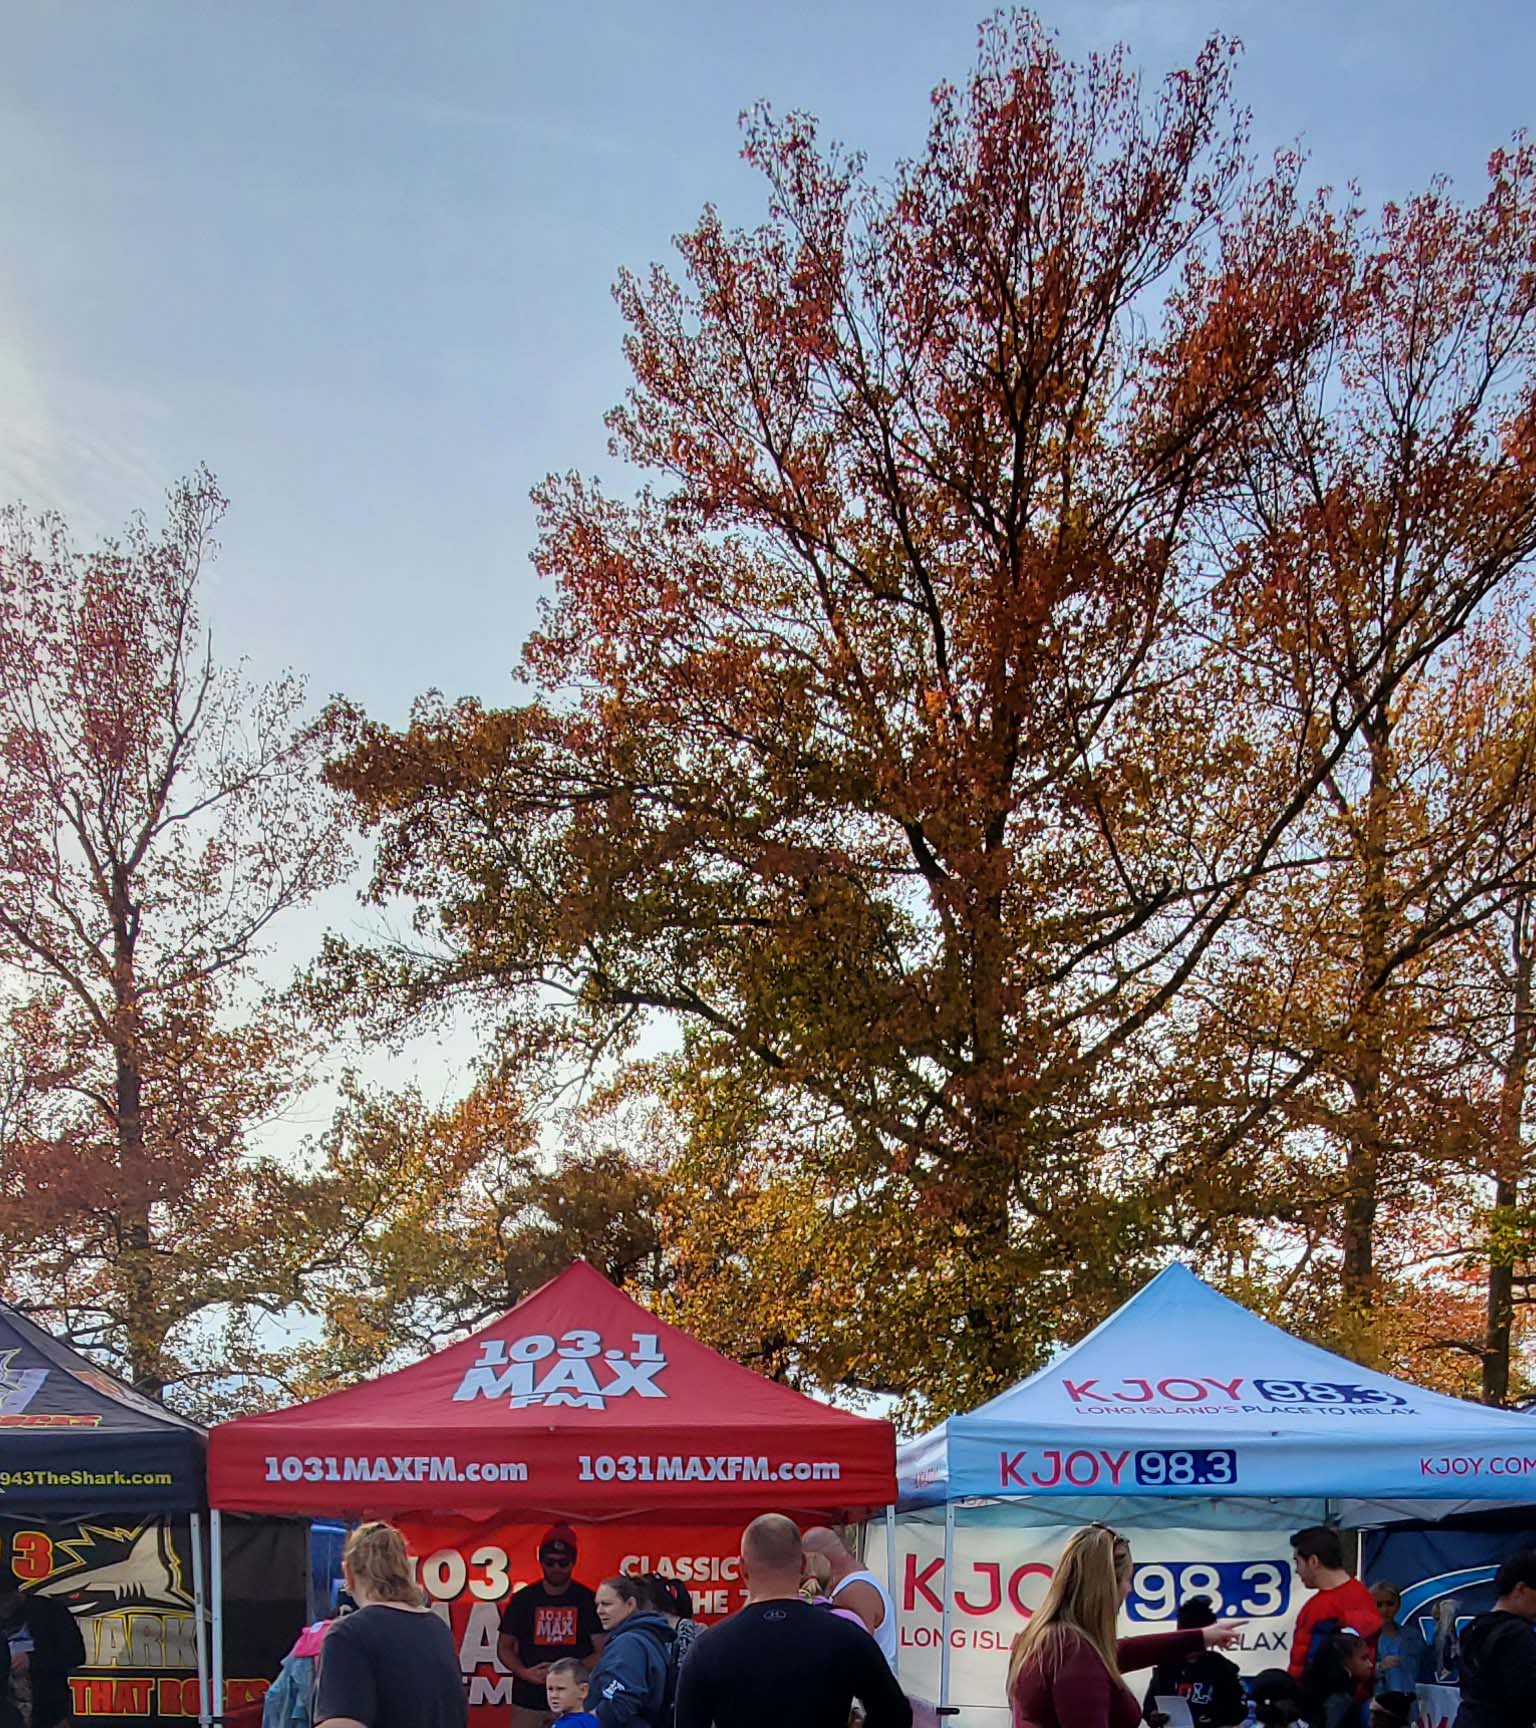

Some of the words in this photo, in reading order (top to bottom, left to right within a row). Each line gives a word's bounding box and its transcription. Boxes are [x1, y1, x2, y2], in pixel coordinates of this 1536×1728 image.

[474, 1330, 665, 1367] 103.1
[452, 1358, 669, 1402] MAX
[1062, 1378, 1244, 1403] KJOY
[1261, 1379, 1398, 1405] 98.3
[509, 1392, 606, 1410] FM
[1074, 1405, 1137, 1415] LONG
[1140, 1405, 1241, 1415] ISLAND'S
[1242, 1405, 1312, 1415] PLACE
[1313, 1406, 1347, 1416] TO
[1350, 1407, 1421, 1416] RELAX
[0, 1469, 173, 1486] 943TheShark.com
[265, 1456, 529, 1483] 1031MAXFM.com
[578, 1455, 841, 1482] 1031MAXFM.com
[999, 1450, 1132, 1488] KJOY
[1139, 1452, 1233, 1485] 98.3
[903, 1553, 1055, 1618] KJO
[1132, 1564, 1284, 1621] 98.3
[688, 1589, 729, 1615] HE
[536, 1618, 574, 1636] MAX
[77, 1615, 198, 1669] ARK
[67, 1676, 157, 1717] THAT
